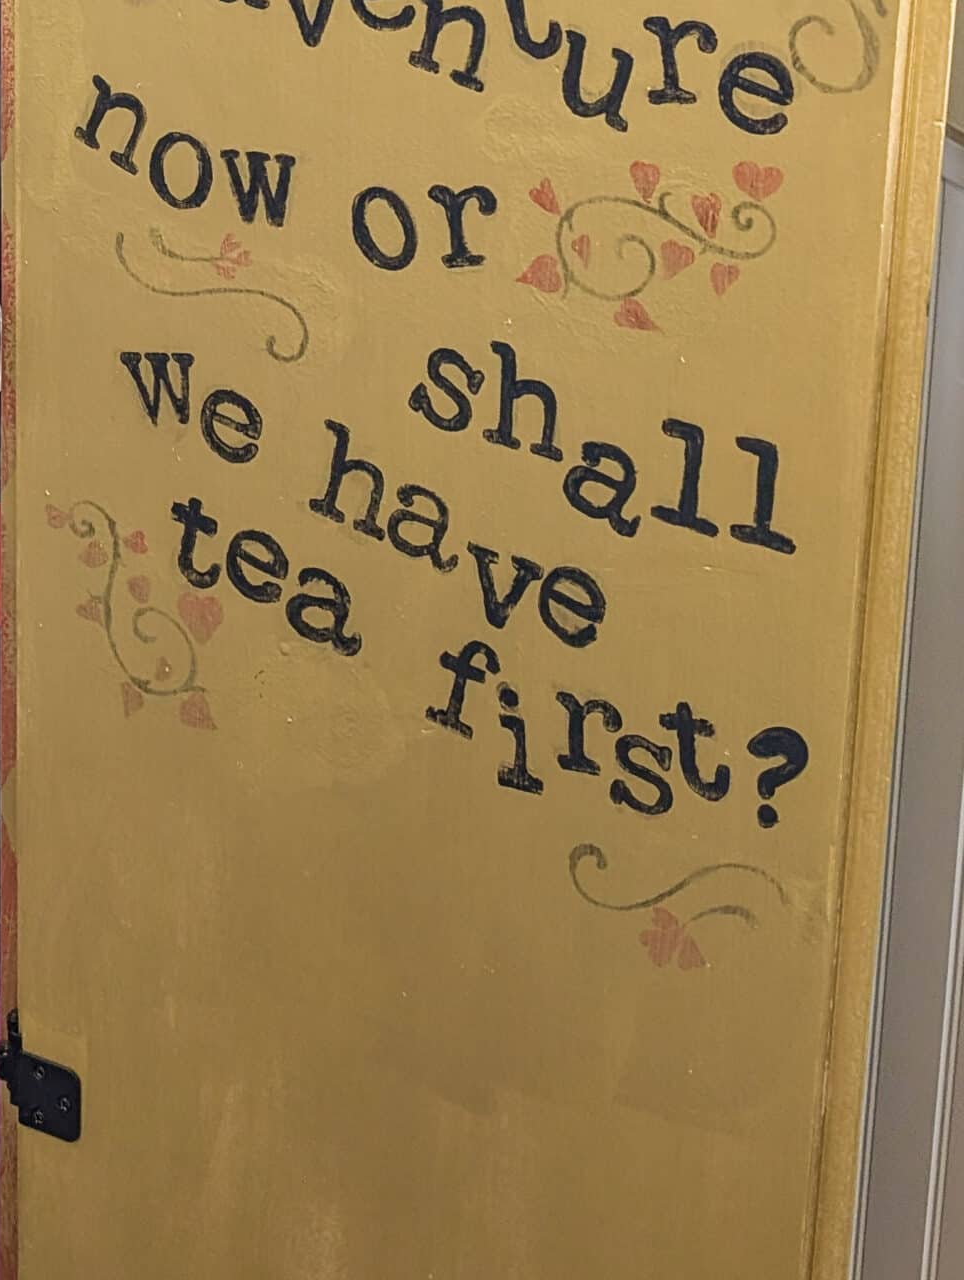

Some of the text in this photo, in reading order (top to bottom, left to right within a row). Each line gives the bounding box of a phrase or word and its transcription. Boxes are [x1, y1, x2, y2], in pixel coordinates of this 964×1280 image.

[72, 73, 498, 271] now or
[120, 352, 606, 648] we have
[408, 340, 797, 555] shall
[170, 497, 809, 828] tea first?
